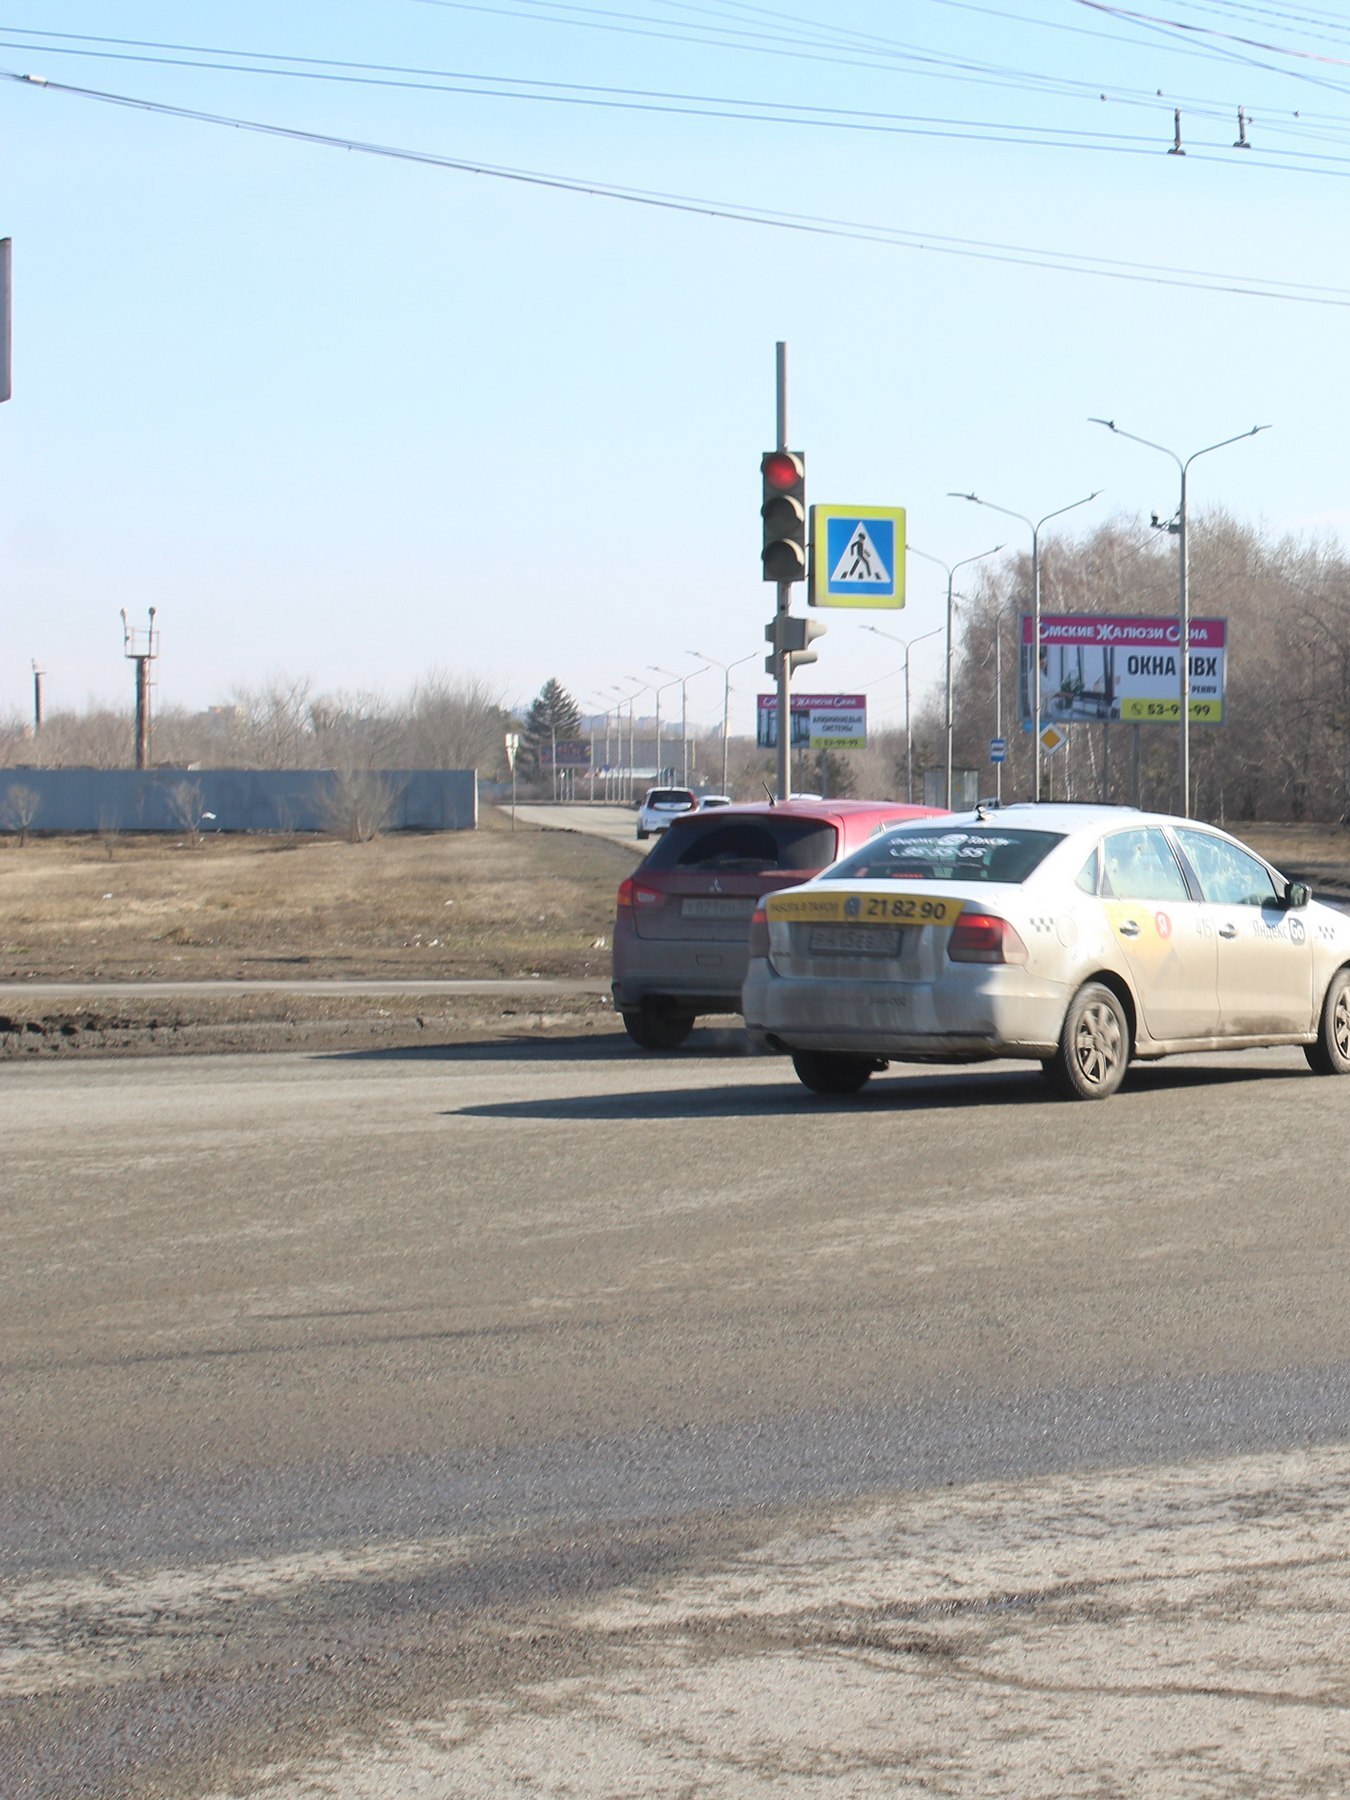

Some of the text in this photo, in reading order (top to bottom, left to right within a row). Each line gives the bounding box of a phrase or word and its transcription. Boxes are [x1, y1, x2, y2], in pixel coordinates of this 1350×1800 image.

[1127, 655, 1176, 676] ОКНА
[867, 899, 946, 920] 21 82 90
